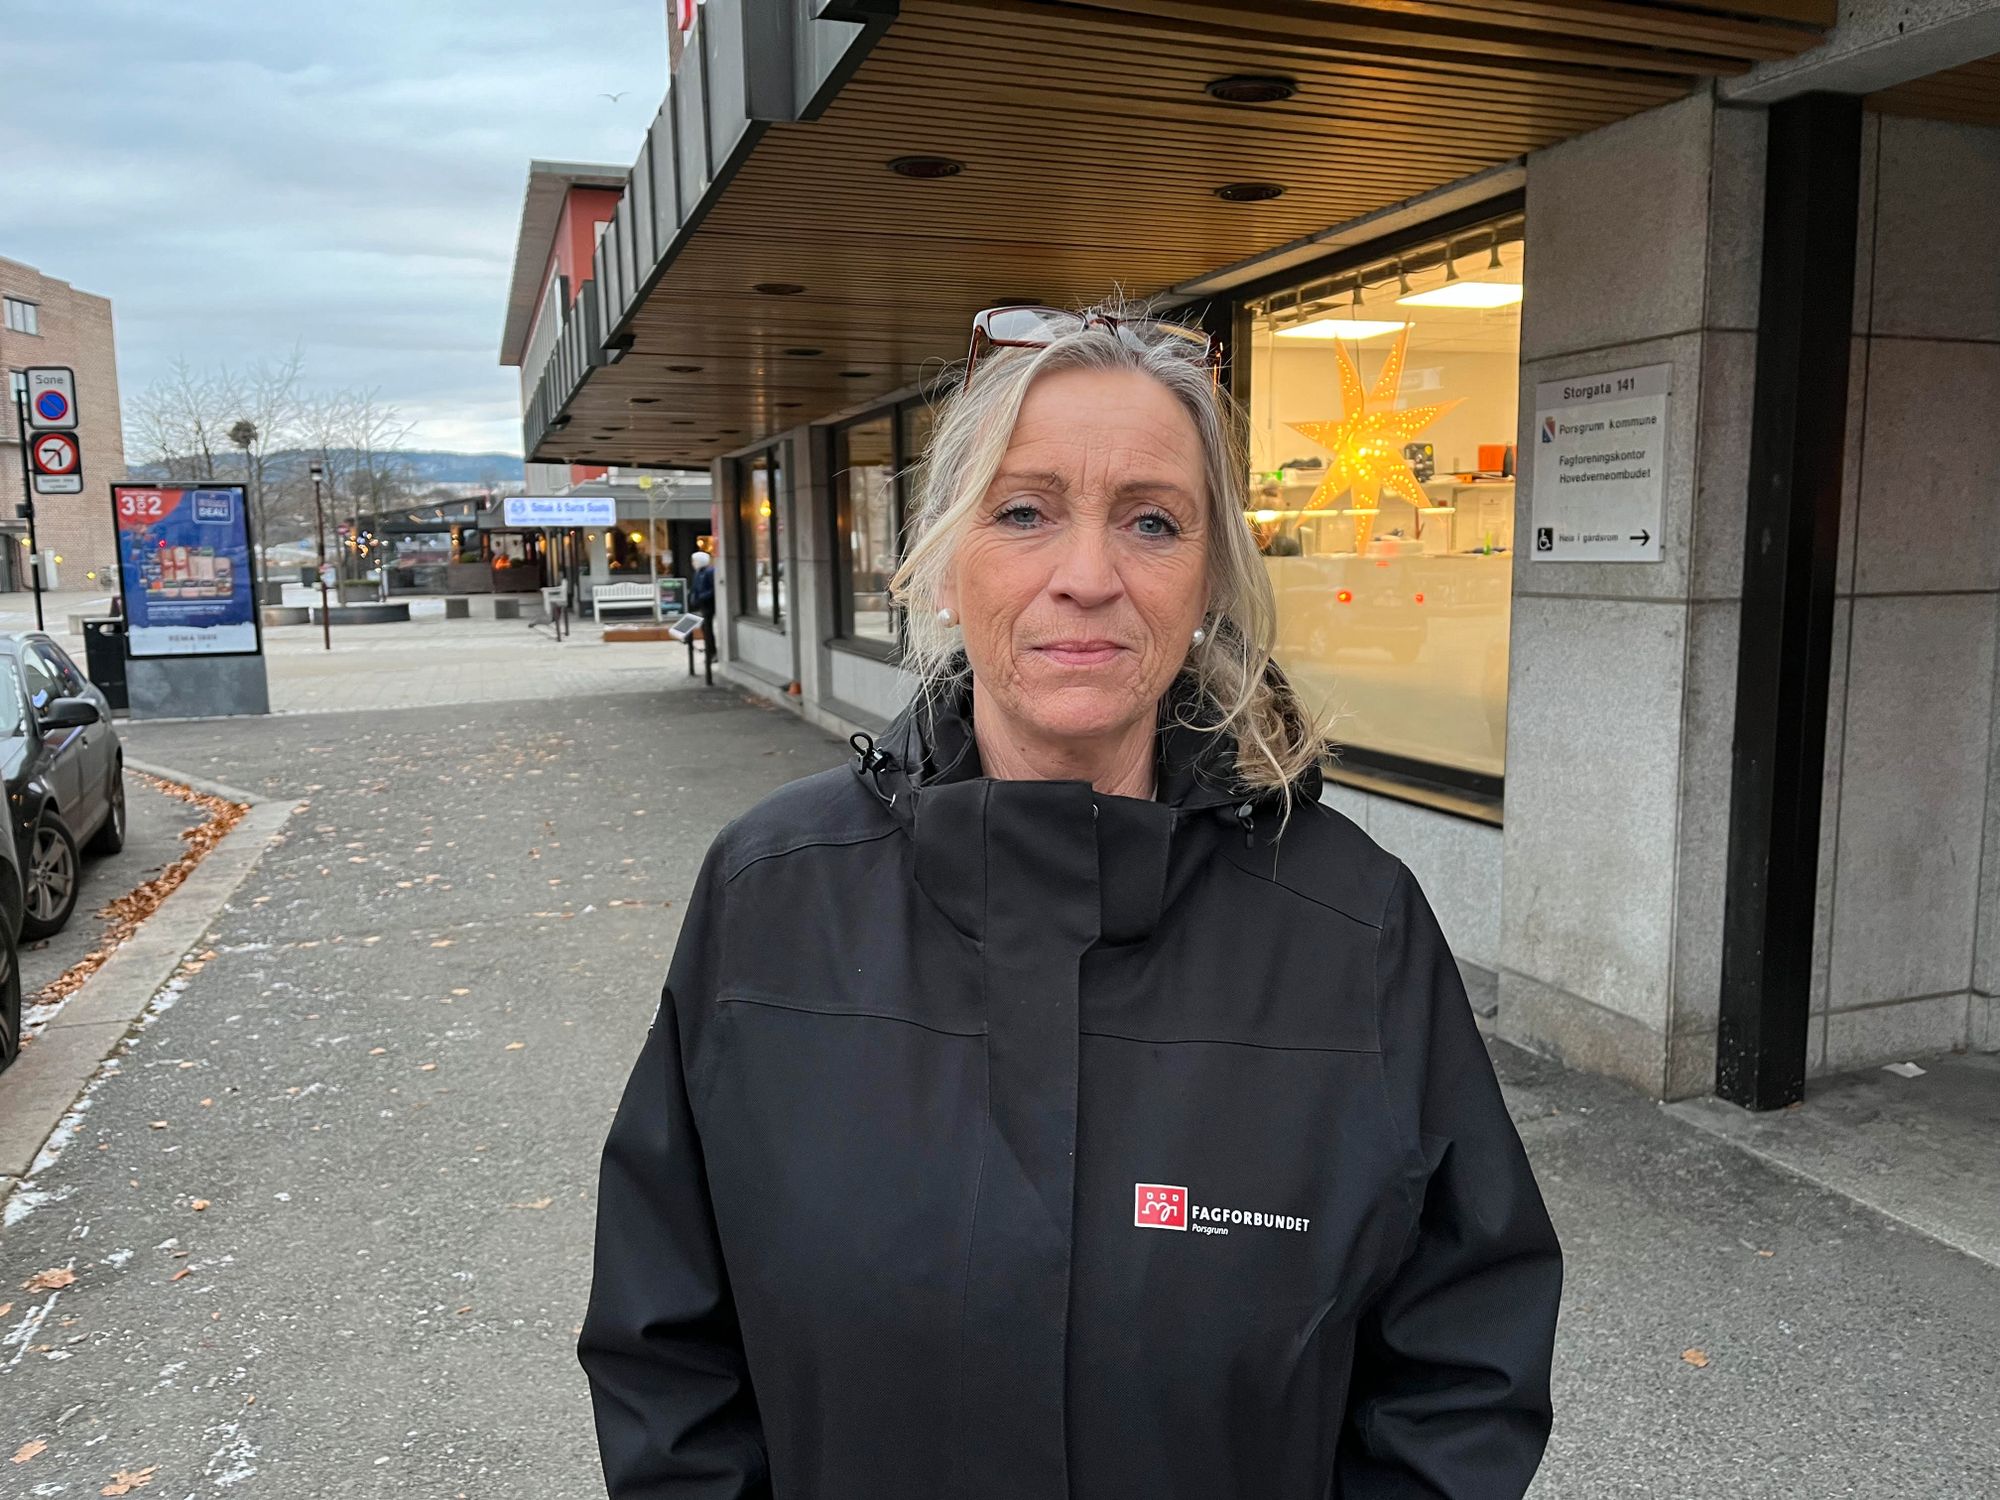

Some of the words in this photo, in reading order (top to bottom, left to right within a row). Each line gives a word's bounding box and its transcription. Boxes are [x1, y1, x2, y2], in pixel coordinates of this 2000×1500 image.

[35, 374, 64, 385] Sone
[1563, 382, 1611, 400] Storgata
[1616, 377, 1635, 391] 141
[1559, 421, 1605, 435] Porsgrunn
[1559, 449, 1646, 467] Fagforeningskontor
[1559, 467, 1651, 484] Hovedverneombudet
[121, 496, 135, 516] 3
[148, 496, 162, 516] 2
[1191, 1205, 1310, 1232] FAGFORBUNDET
[1191, 1223, 1229, 1236] Porsgrunn
